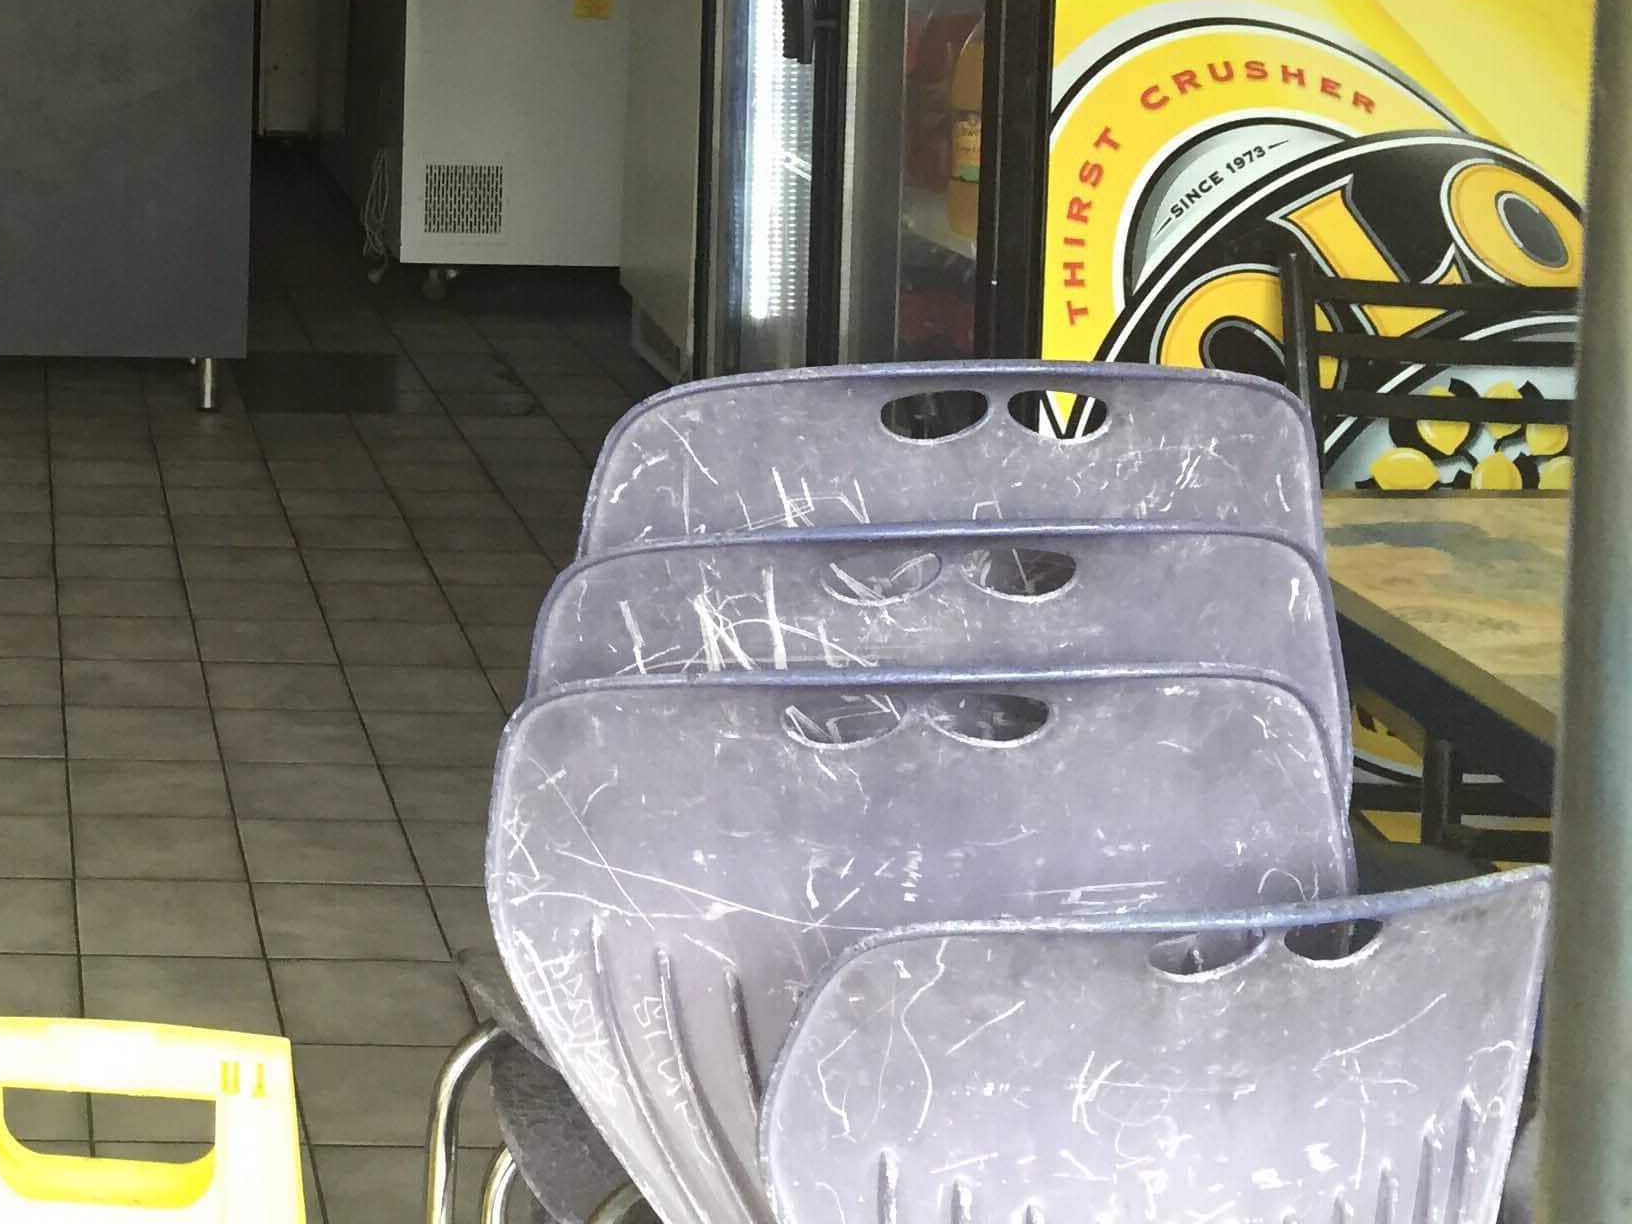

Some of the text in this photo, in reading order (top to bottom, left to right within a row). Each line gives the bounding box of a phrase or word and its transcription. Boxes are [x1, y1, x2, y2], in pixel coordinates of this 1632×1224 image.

[1062, 126, 1123, 327] THIRST
[1139, 59, 1377, 116] CRUSHER
[1168, 144, 1267, 221] SINCE 1973
